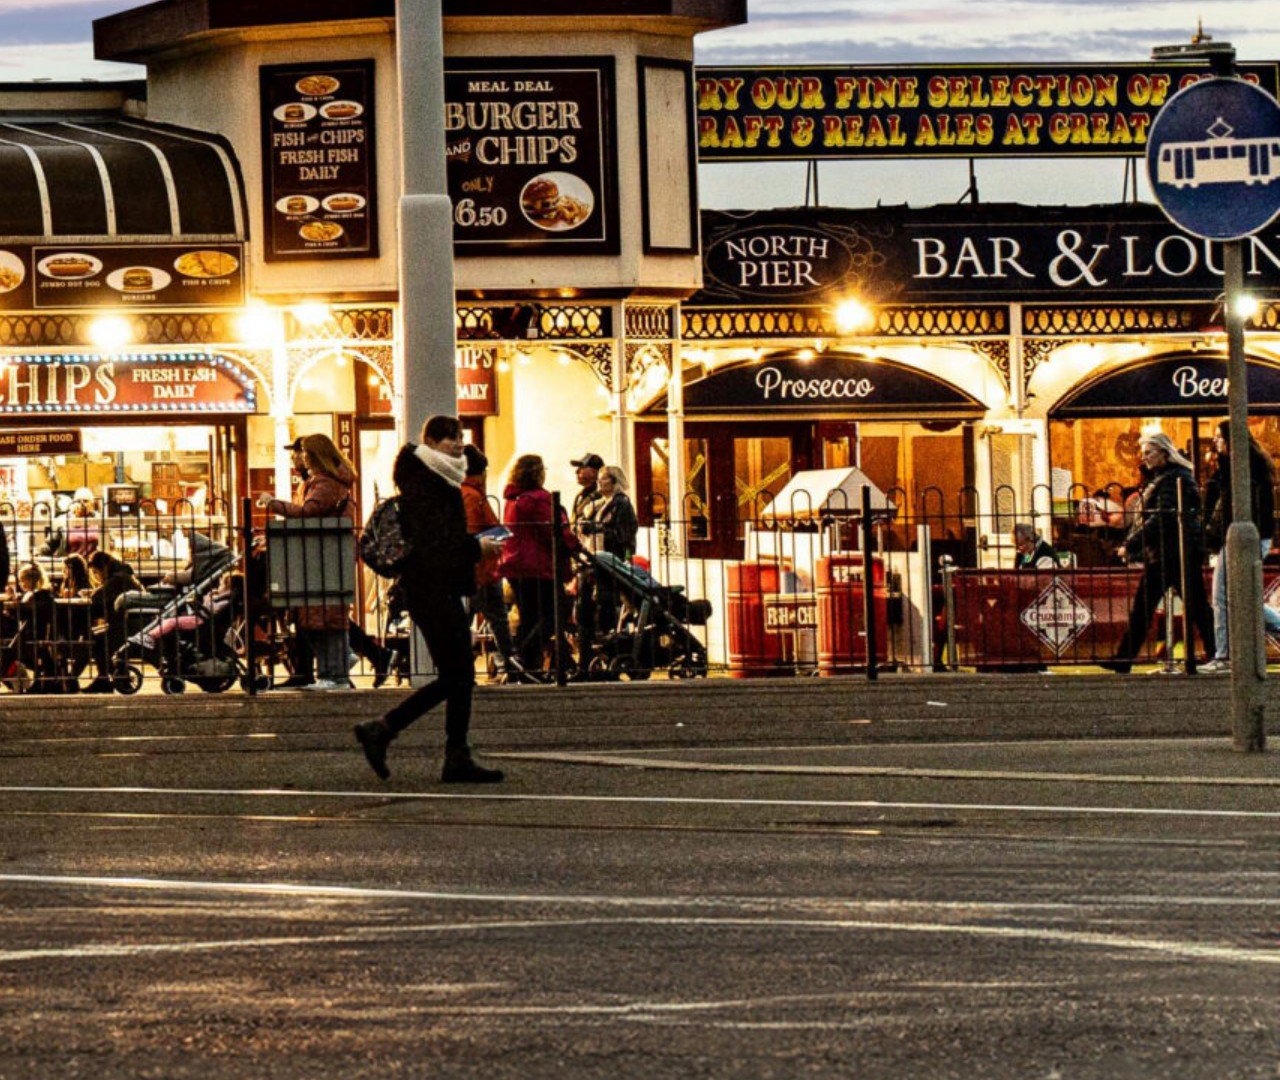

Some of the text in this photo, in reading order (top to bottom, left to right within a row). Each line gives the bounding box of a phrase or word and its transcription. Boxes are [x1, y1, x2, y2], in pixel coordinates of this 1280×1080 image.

[468, 80, 553, 93] MEAL DEAL
[697, 77, 744, 111] RY
[751, 76, 826, 110] OUR
[834, 76, 920, 109] FINE
[927, 74, 1119, 109] SELECTION
[1126, 73, 1171, 107] OF
[444, 101, 582, 131] BURGER
[273, 131, 305, 147] FISH
[320, 129, 364, 144] CHIPS
[698, 111, 1151, 148] RAFT & REAL ALES AT GREAT
[280, 148, 359, 165] FRESH FISH
[445, 135, 578, 165] AND CHIPS
[299, 166, 339, 180] DAILY
[461, 176, 494, 193] ONLY
[454, 198, 508, 227] 6.50
[725, 234, 830, 261] NORTH
[911, 228, 1280, 288] BAR & LOUN
[738, 260, 822, 287] PIER
[84, 280, 101, 288] DOG
[455, 346, 493, 369] HIPS
[132, 367, 217, 383] FRESH FISH
[755, 366, 875, 399] Prosecco
[153, 384, 197, 399] DAILY
[17, 434, 47, 444] ORDER
[48, 433, 74, 443] FOOD
[1029, 611, 1086, 623] Cruzamo
